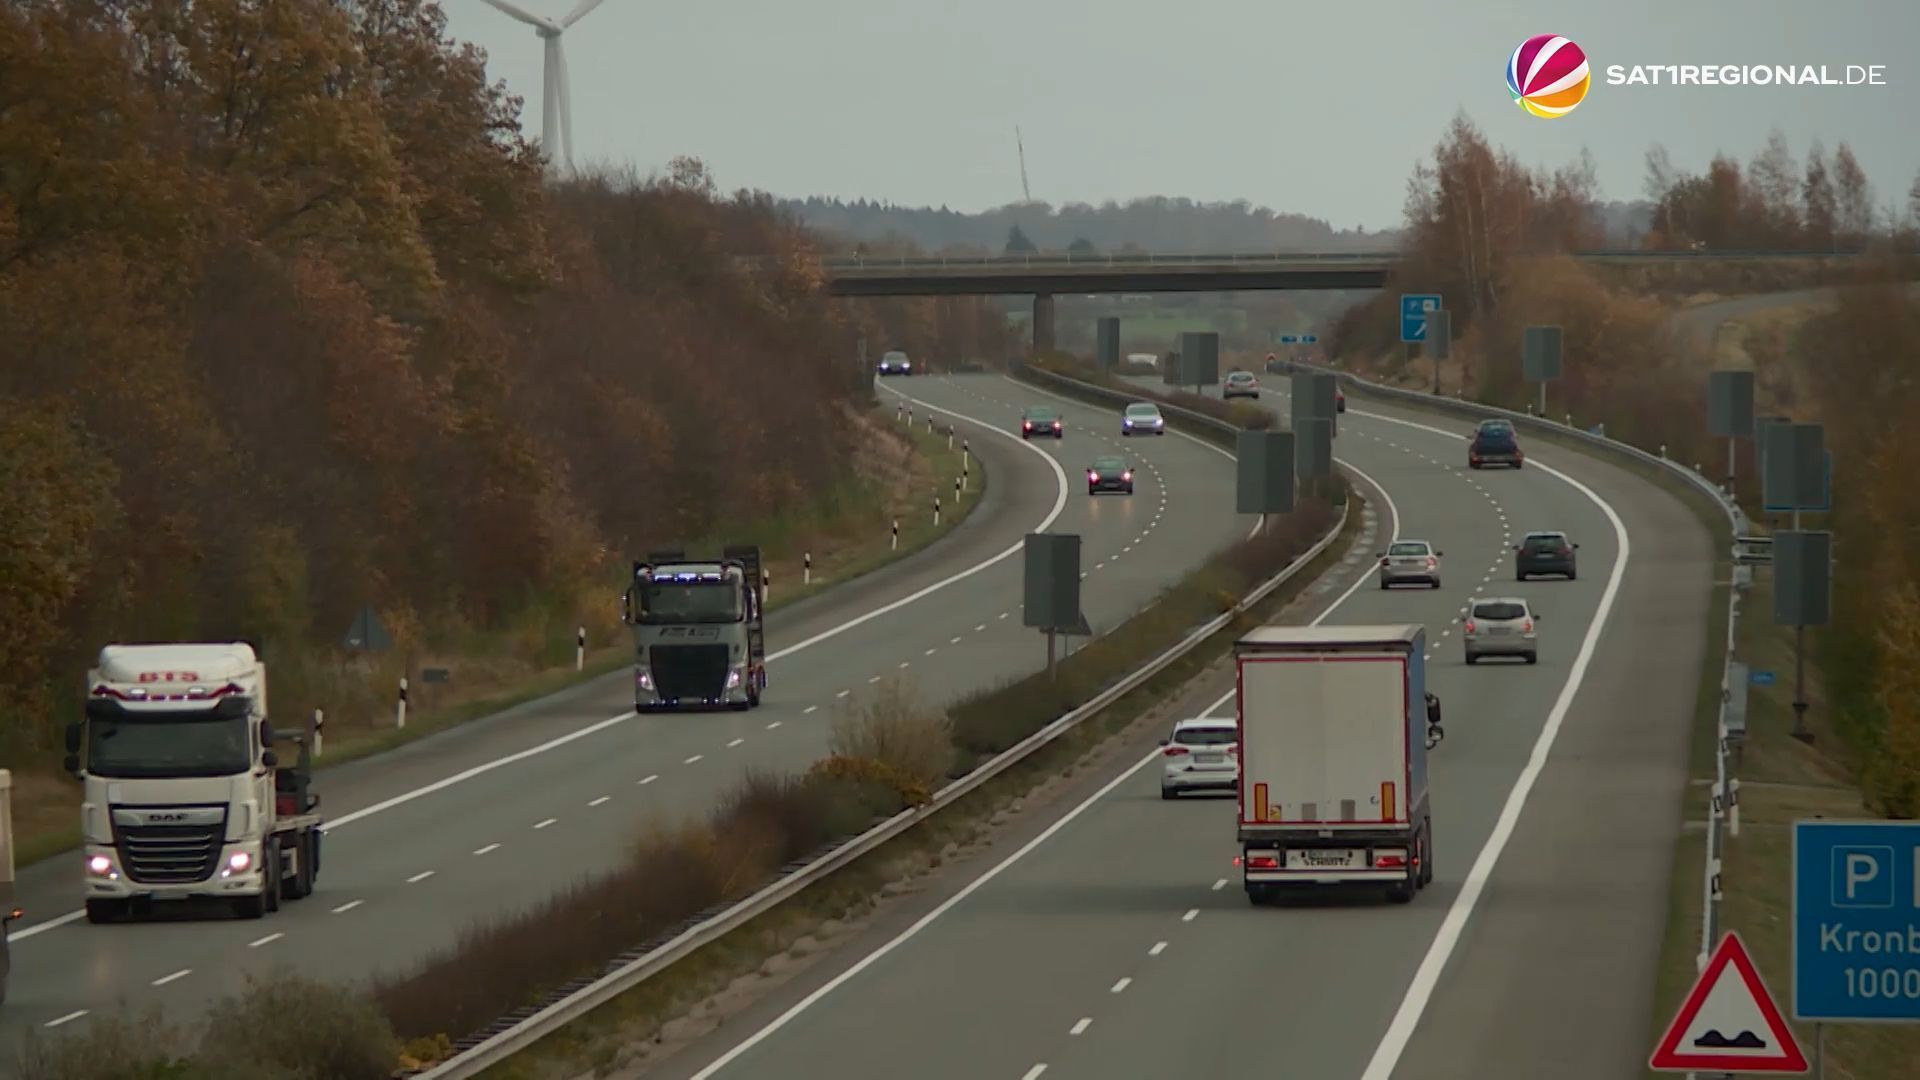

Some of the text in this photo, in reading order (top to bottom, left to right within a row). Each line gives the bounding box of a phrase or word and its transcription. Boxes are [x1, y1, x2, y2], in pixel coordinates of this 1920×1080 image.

[149, 813, 189, 822] DAF
[1847, 853, 1879, 898] P
[1844, 967, 1920, 998] 1000
